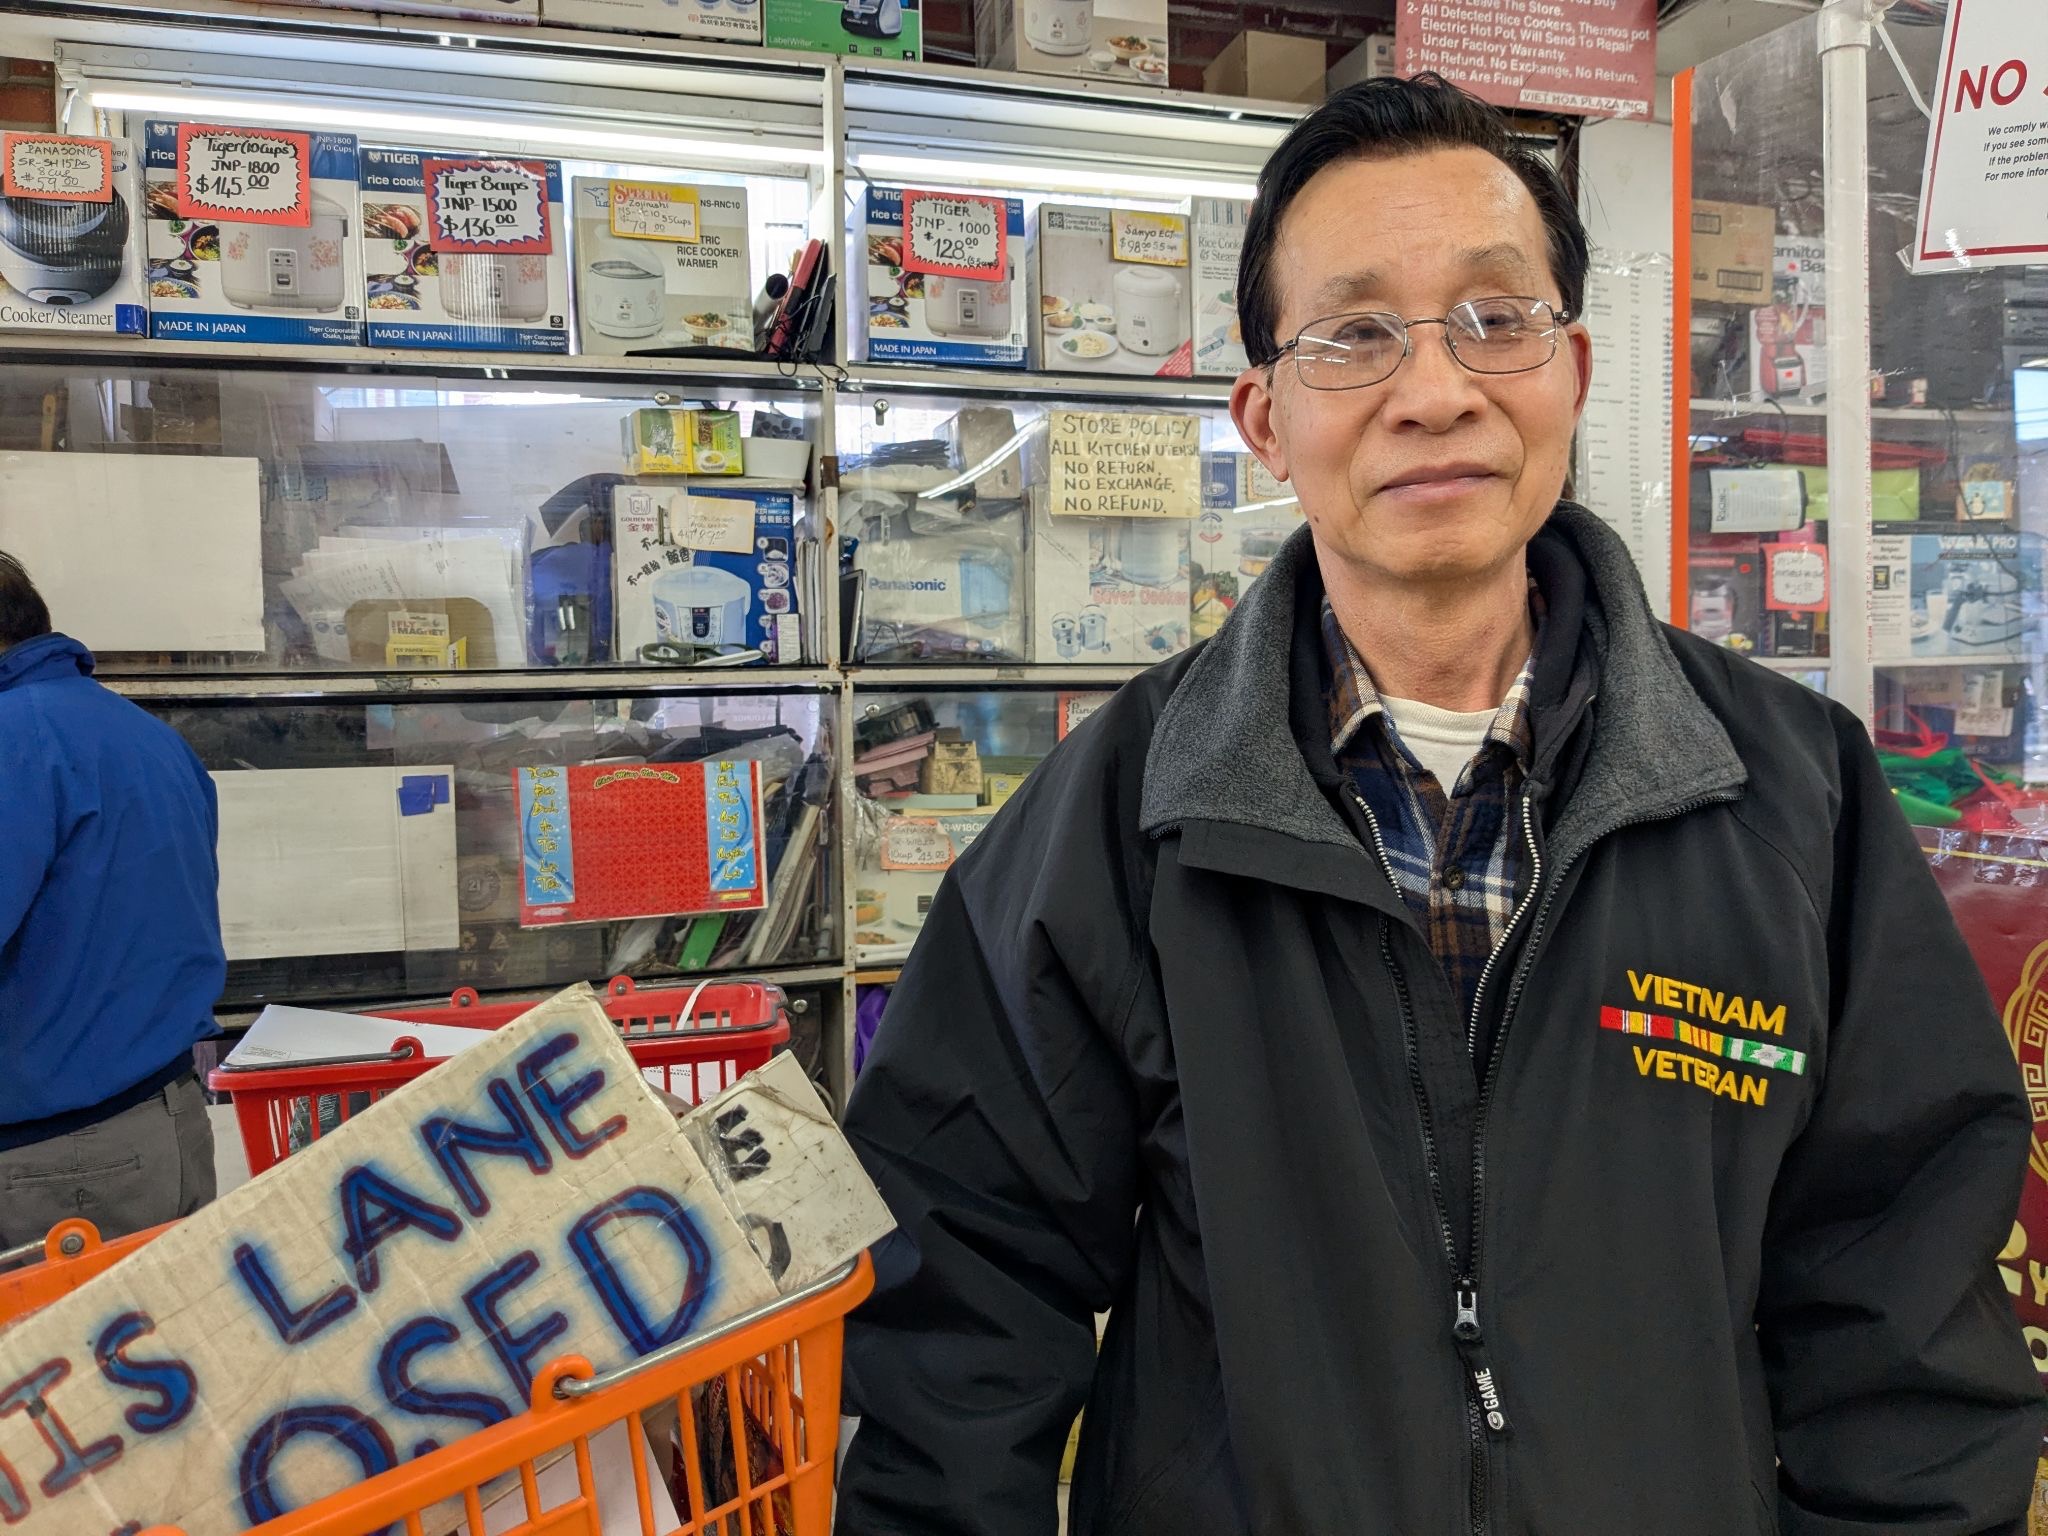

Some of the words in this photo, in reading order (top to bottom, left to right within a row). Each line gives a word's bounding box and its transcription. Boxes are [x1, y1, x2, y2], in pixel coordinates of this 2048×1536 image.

[1505, 0, 1525, 11] The
[1529, 1, 1564, 16] Store.
[1407, 2, 1418, 14] 2-
[1421, 4, 1437, 17] All
[1441, 6, 1492, 22] Defected
[1495, 12, 1520, 26] Rice
[1524, 16, 1576, 34] Cookers,
[1579, 22, 1629, 38] Thermos
[1631, 30, 1650, 42] pot
[769, 36, 813, 46] LabelWriter
[1421, 18, 1467, 34] Electric
[1471, 24, 1492, 36] Hot
[1520, 29, 1542, 43] Will
[1546, 32, 1576, 46] Send
[1579, 36, 1594, 48] To
[1597, 38, 1634, 53] Repair
[1423, 34, 1459, 49] Under
[1462, 38, 1508, 56] Factory
[1510, 43, 1567, 63] Warranty.
[1406, 48, 1418, 60] 3-
[1420, 49, 1438, 61] No
[1490, 57, 1508, 69] No
[1575, 66, 1593, 79] No
[1595, 68, 1639, 84] Return.
[1420, 64, 1437, 76] All
[1441, 66, 1466, 81] Sale
[1470, 70, 1491, 84] Are
[1493, 73, 1523, 87] Final
[1954, 59, 2028, 114] NO
[1523, 91, 1548, 101] VIET
[1552, 94, 1578, 105] HOA
[1581, 97, 1619, 109] PLAZA
[1988, 126, 2001, 136] We
[2004, 121, 2037, 134] comply
[25, 144, 98, 157] PANASONIC
[206, 138, 240, 160] Tiger
[333, 145, 351, 154] Cups
[1984, 142, 1990, 152] If
[1992, 142, 2008, 152] you
[2009, 139, 2025, 149] see
[151, 150, 177, 160] rice
[381, 152, 419, 164] TIGER
[1989, 157, 1996, 166] If
[1997, 156, 2011, 165] the
[211, 160, 280, 174] JNP-1800
[367, 175, 390, 186] rice
[1985, 172, 1999, 181] For
[2001, 170, 2024, 179] more
[442, 176, 479, 195] Tiger
[700, 199, 740, 210] NS-RNC10
[871, 210, 890, 220] rice
[1125, 225, 1157, 242] Sanyo
[1199, 236, 1217, 248] Rice
[677, 246, 698, 256] RICE
[678, 258, 719, 269] WARMER
[159, 320, 193, 332] MADE
[196, 321, 209, 332] IN
[212, 322, 246, 335] JAPAN
[308, 326, 323, 335] Tiger
[324, 327, 360, 336] Corporation
[322, 333, 342, 341] Osaka,
[343, 333, 360, 342] Japan
[375, 329, 405, 339] MADE
[408, 331, 420, 340] IN
[423, 331, 453, 343] JAPAN
[550, 340, 566, 348] Japan
[874, 344, 899, 353] MADE
[901, 345, 910, 353] IN
[912, 346, 936, 356] JAPAN
[1062, 414, 1122, 435] STORE
[1129, 416, 1192, 439] POLICY
[1051, 440, 1081, 457] ALL
[1087, 441, 1152, 457] KITCHEN
[1064, 461, 1089, 476] NO
[1096, 461, 1163, 476] RETURN.
[1064, 477, 1091, 491] NO
[1096, 477, 1176, 494] EXCHANGE.
[1064, 496, 1092, 511] NO
[1098, 495, 1167, 515] REFUND.
[868, 578, 946, 591] Panasonic
[397, 620, 416, 628] FLY
[1626, 969, 1787, 1036] VIETNAM
[1632, 1045, 1768, 1107] VETERAN
[234, 1032, 628, 1344] LANE
[1474, 1366, 1500, 1411] GAME
